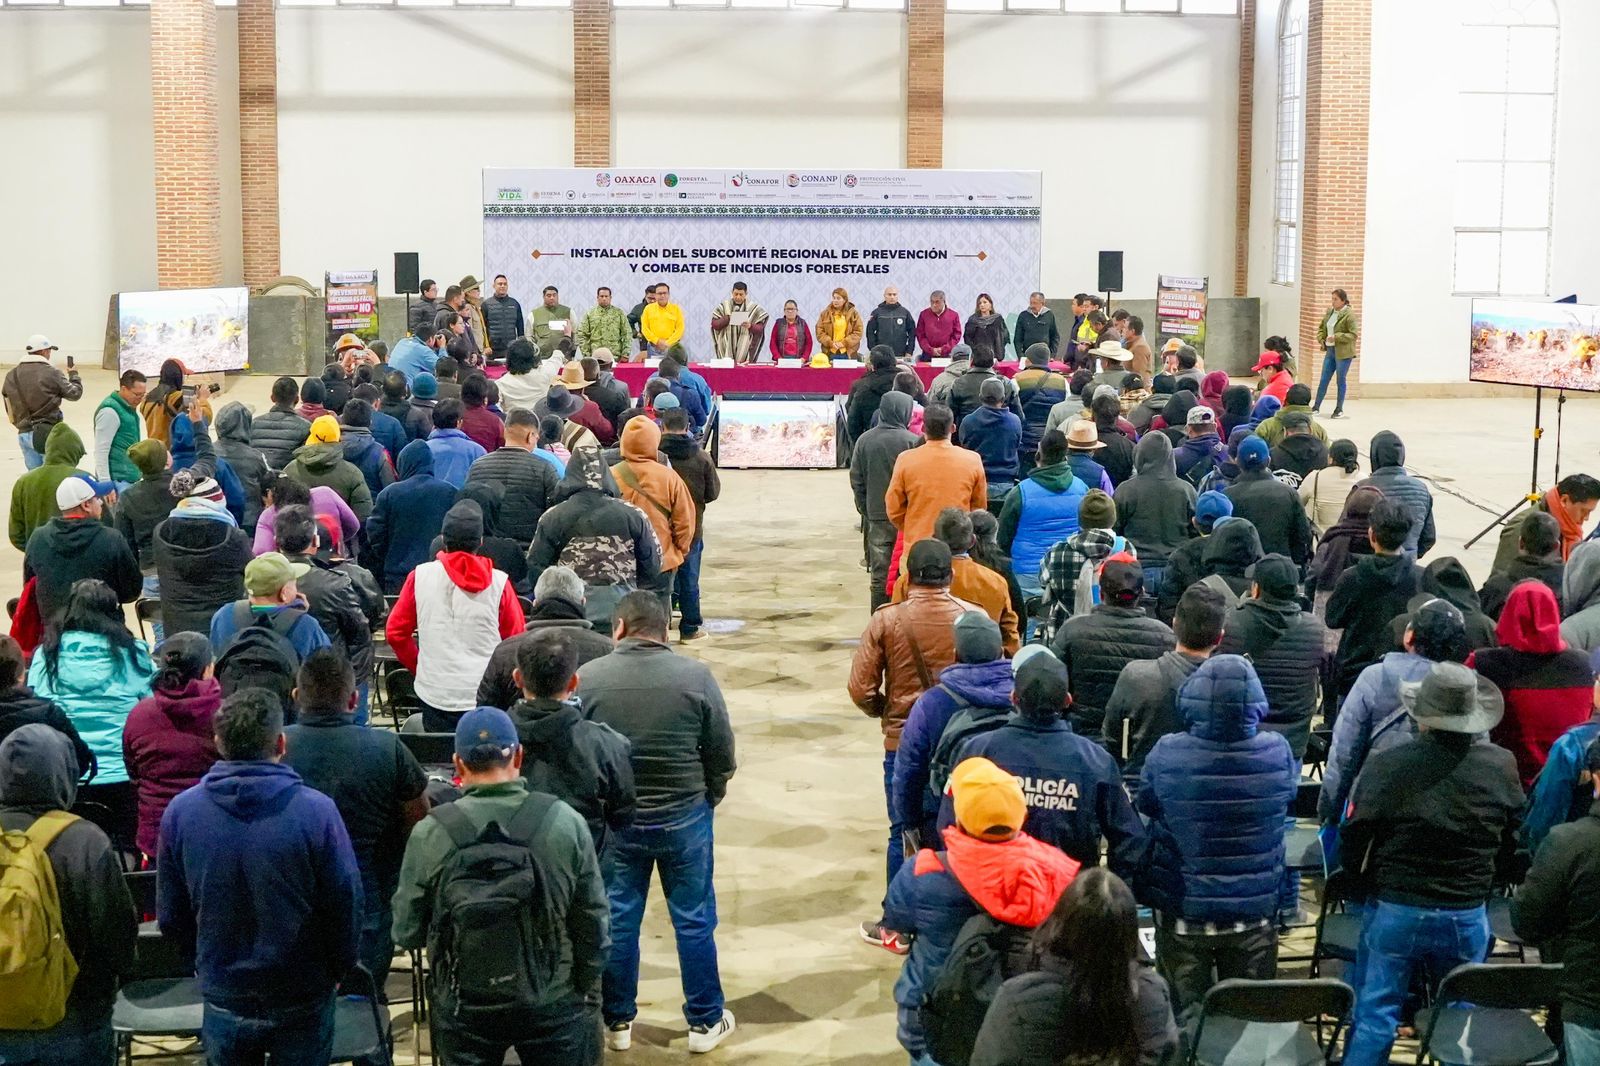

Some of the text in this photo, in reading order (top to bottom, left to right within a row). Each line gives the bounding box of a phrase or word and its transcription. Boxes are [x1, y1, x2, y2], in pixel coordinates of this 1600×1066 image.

[615, 176, 657, 184] OAXACA
[570, 246, 948, 260] INSTALACIÓN DEL SUBCOMITÉ REGIONAL DE PREVENCIÓN
[629, 263, 890, 274] Y COMBATE DE INCENDIOS FORESTALES
[359, 303, 371, 313] NO
[1188, 309, 1200, 320] NO
[1013, 775, 1079, 799] OLICÍA
